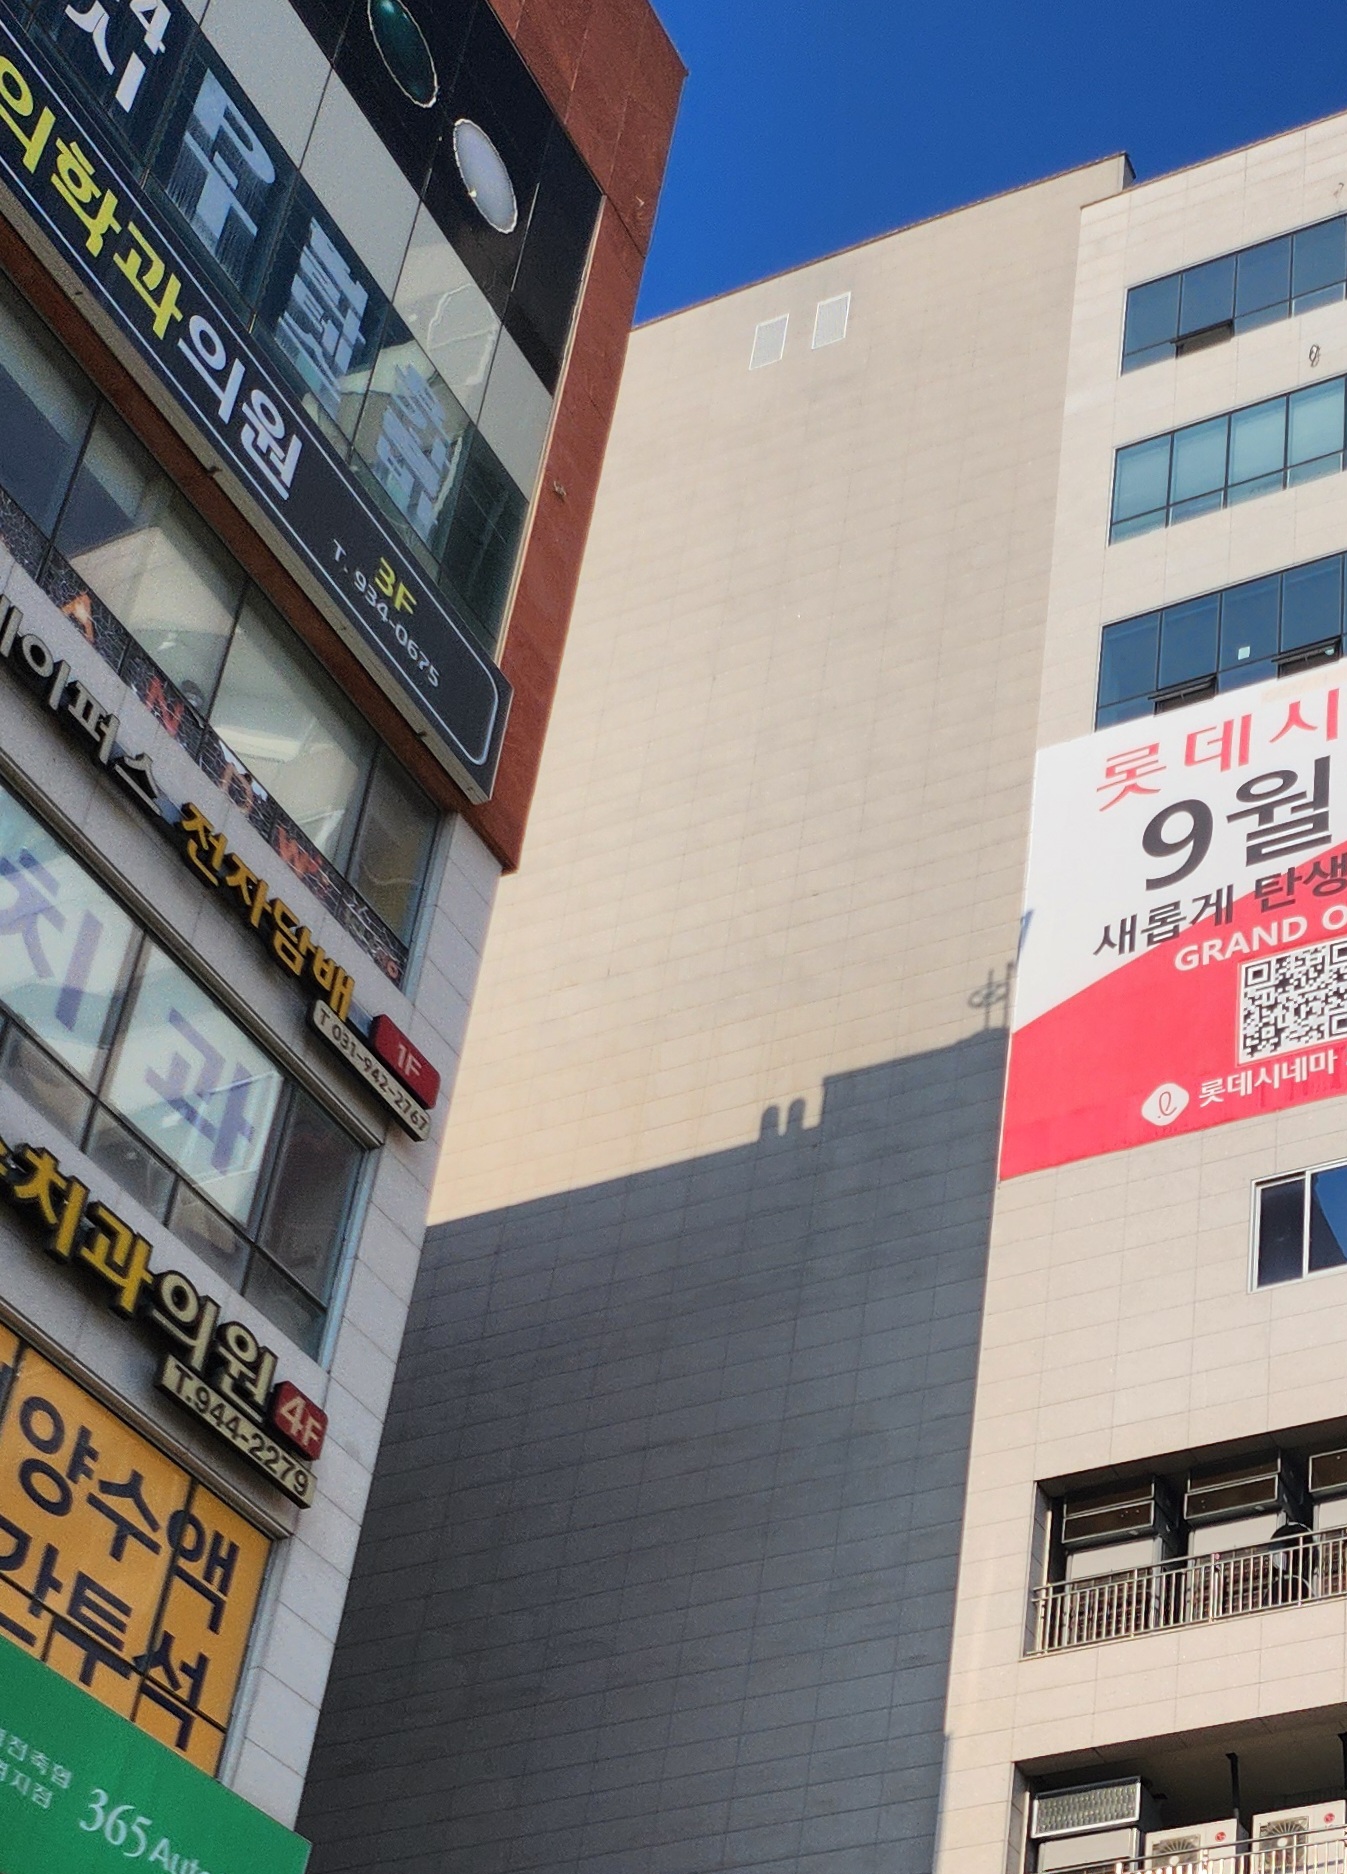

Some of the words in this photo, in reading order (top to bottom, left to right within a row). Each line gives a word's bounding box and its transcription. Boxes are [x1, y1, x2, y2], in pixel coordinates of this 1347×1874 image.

[374, 557, 417, 615] 3F
[353, 569, 441, 688] 934-0675
[180, 802, 356, 1022] 전자담배
[1093, 884, 1234, 958] 새롭게
[1174, 914, 1308, 972] GRAND
[318, 1010, 333, 1030] T
[331, 1023, 431, 1135] 031-942-2767
[397, 1044, 423, 1080] 1F
[1199, 1048, 1338, 1108] 롯데시네마
[0, 1117, 281, 1425] 치과의원
[280, 1393, 322, 1449] 4F
[79, 1787, 153, 1860] 365
